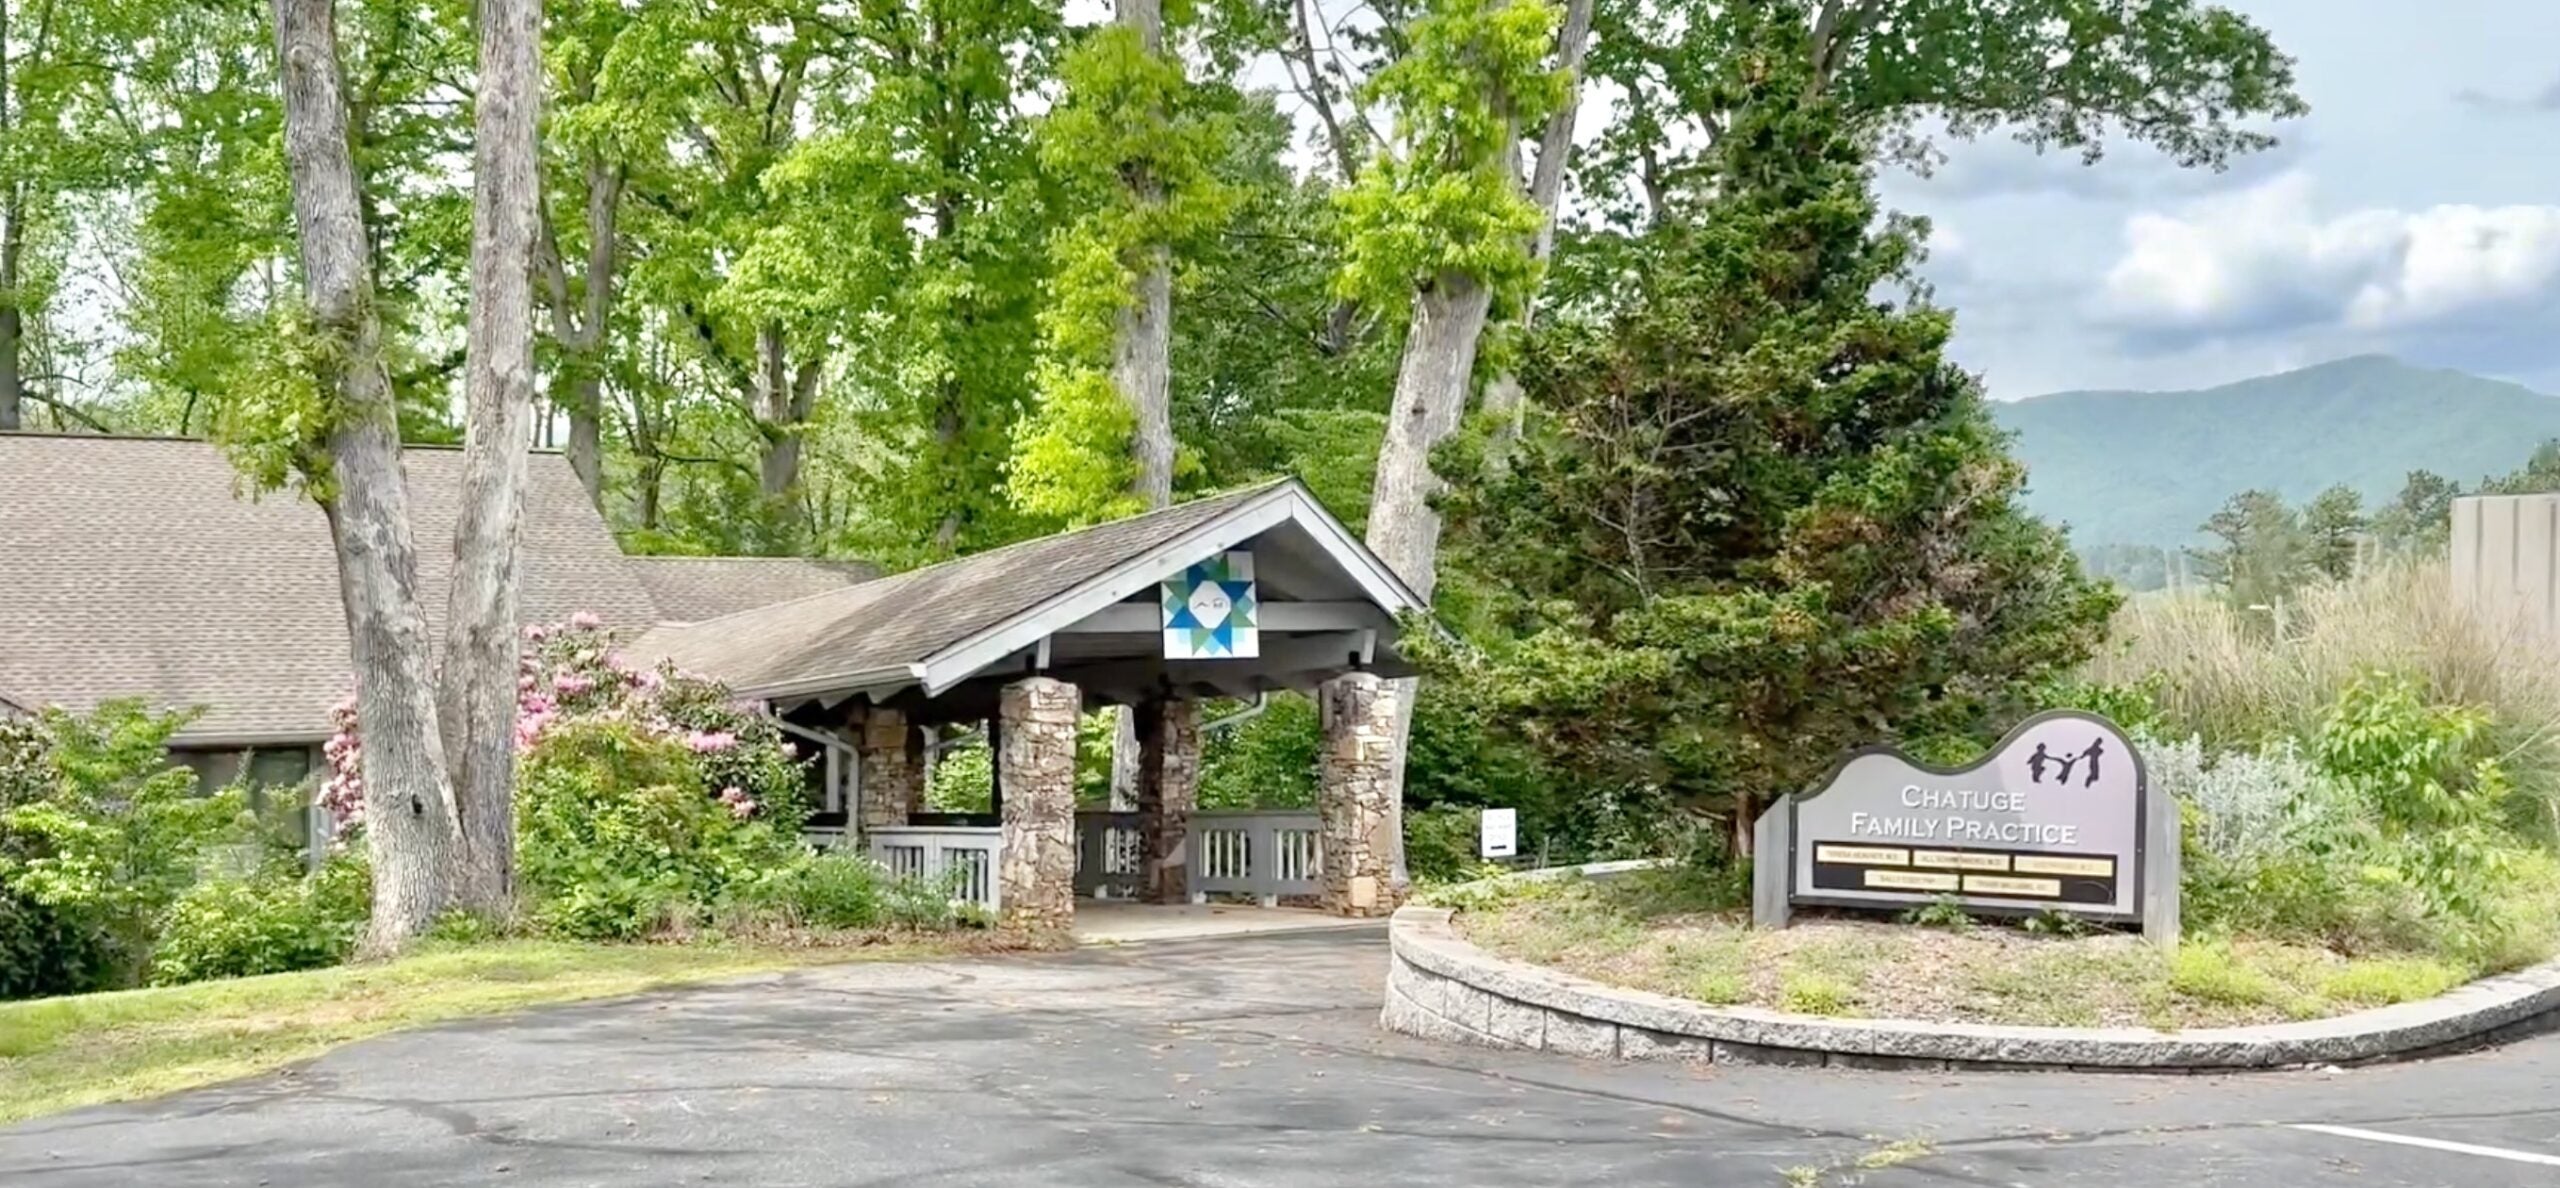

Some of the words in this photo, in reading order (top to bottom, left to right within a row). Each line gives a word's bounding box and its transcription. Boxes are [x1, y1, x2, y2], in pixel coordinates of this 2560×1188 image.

[1901, 784, 2025, 811] CHATUGE
[1851, 812, 1939, 838] FAMILY
[1946, 816, 2077, 844] PRACTICE
